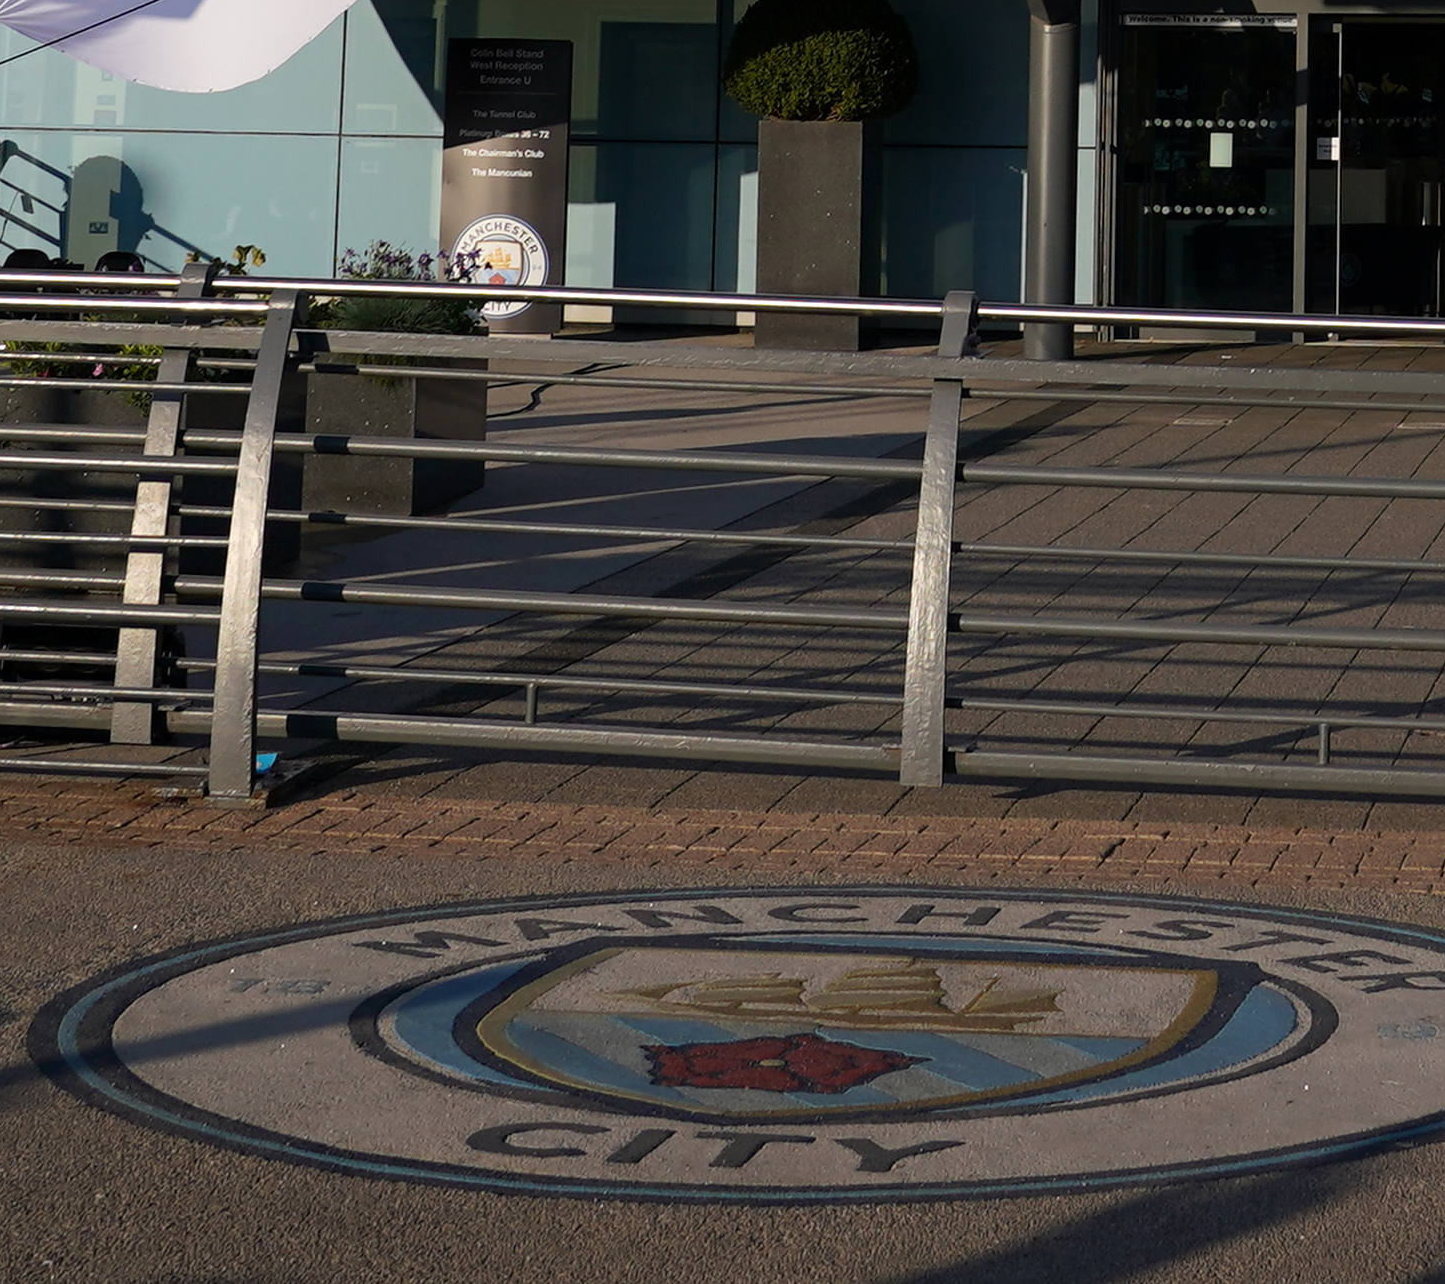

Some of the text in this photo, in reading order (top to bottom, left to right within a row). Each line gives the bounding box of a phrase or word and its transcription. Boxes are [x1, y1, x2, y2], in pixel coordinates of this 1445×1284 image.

[516, 49, 544, 59] Stand
[470, 60, 543, 72] West Reception
[480, 75, 522, 85] Entrance
[516, 109, 536, 119] Club
[462, 148, 545, 159] The Chairman's Club
[472, 168, 533, 178] The Mancunian
[461, 221, 539, 255] MANCHESTER
[465, 1121, 967, 1172] CITY
